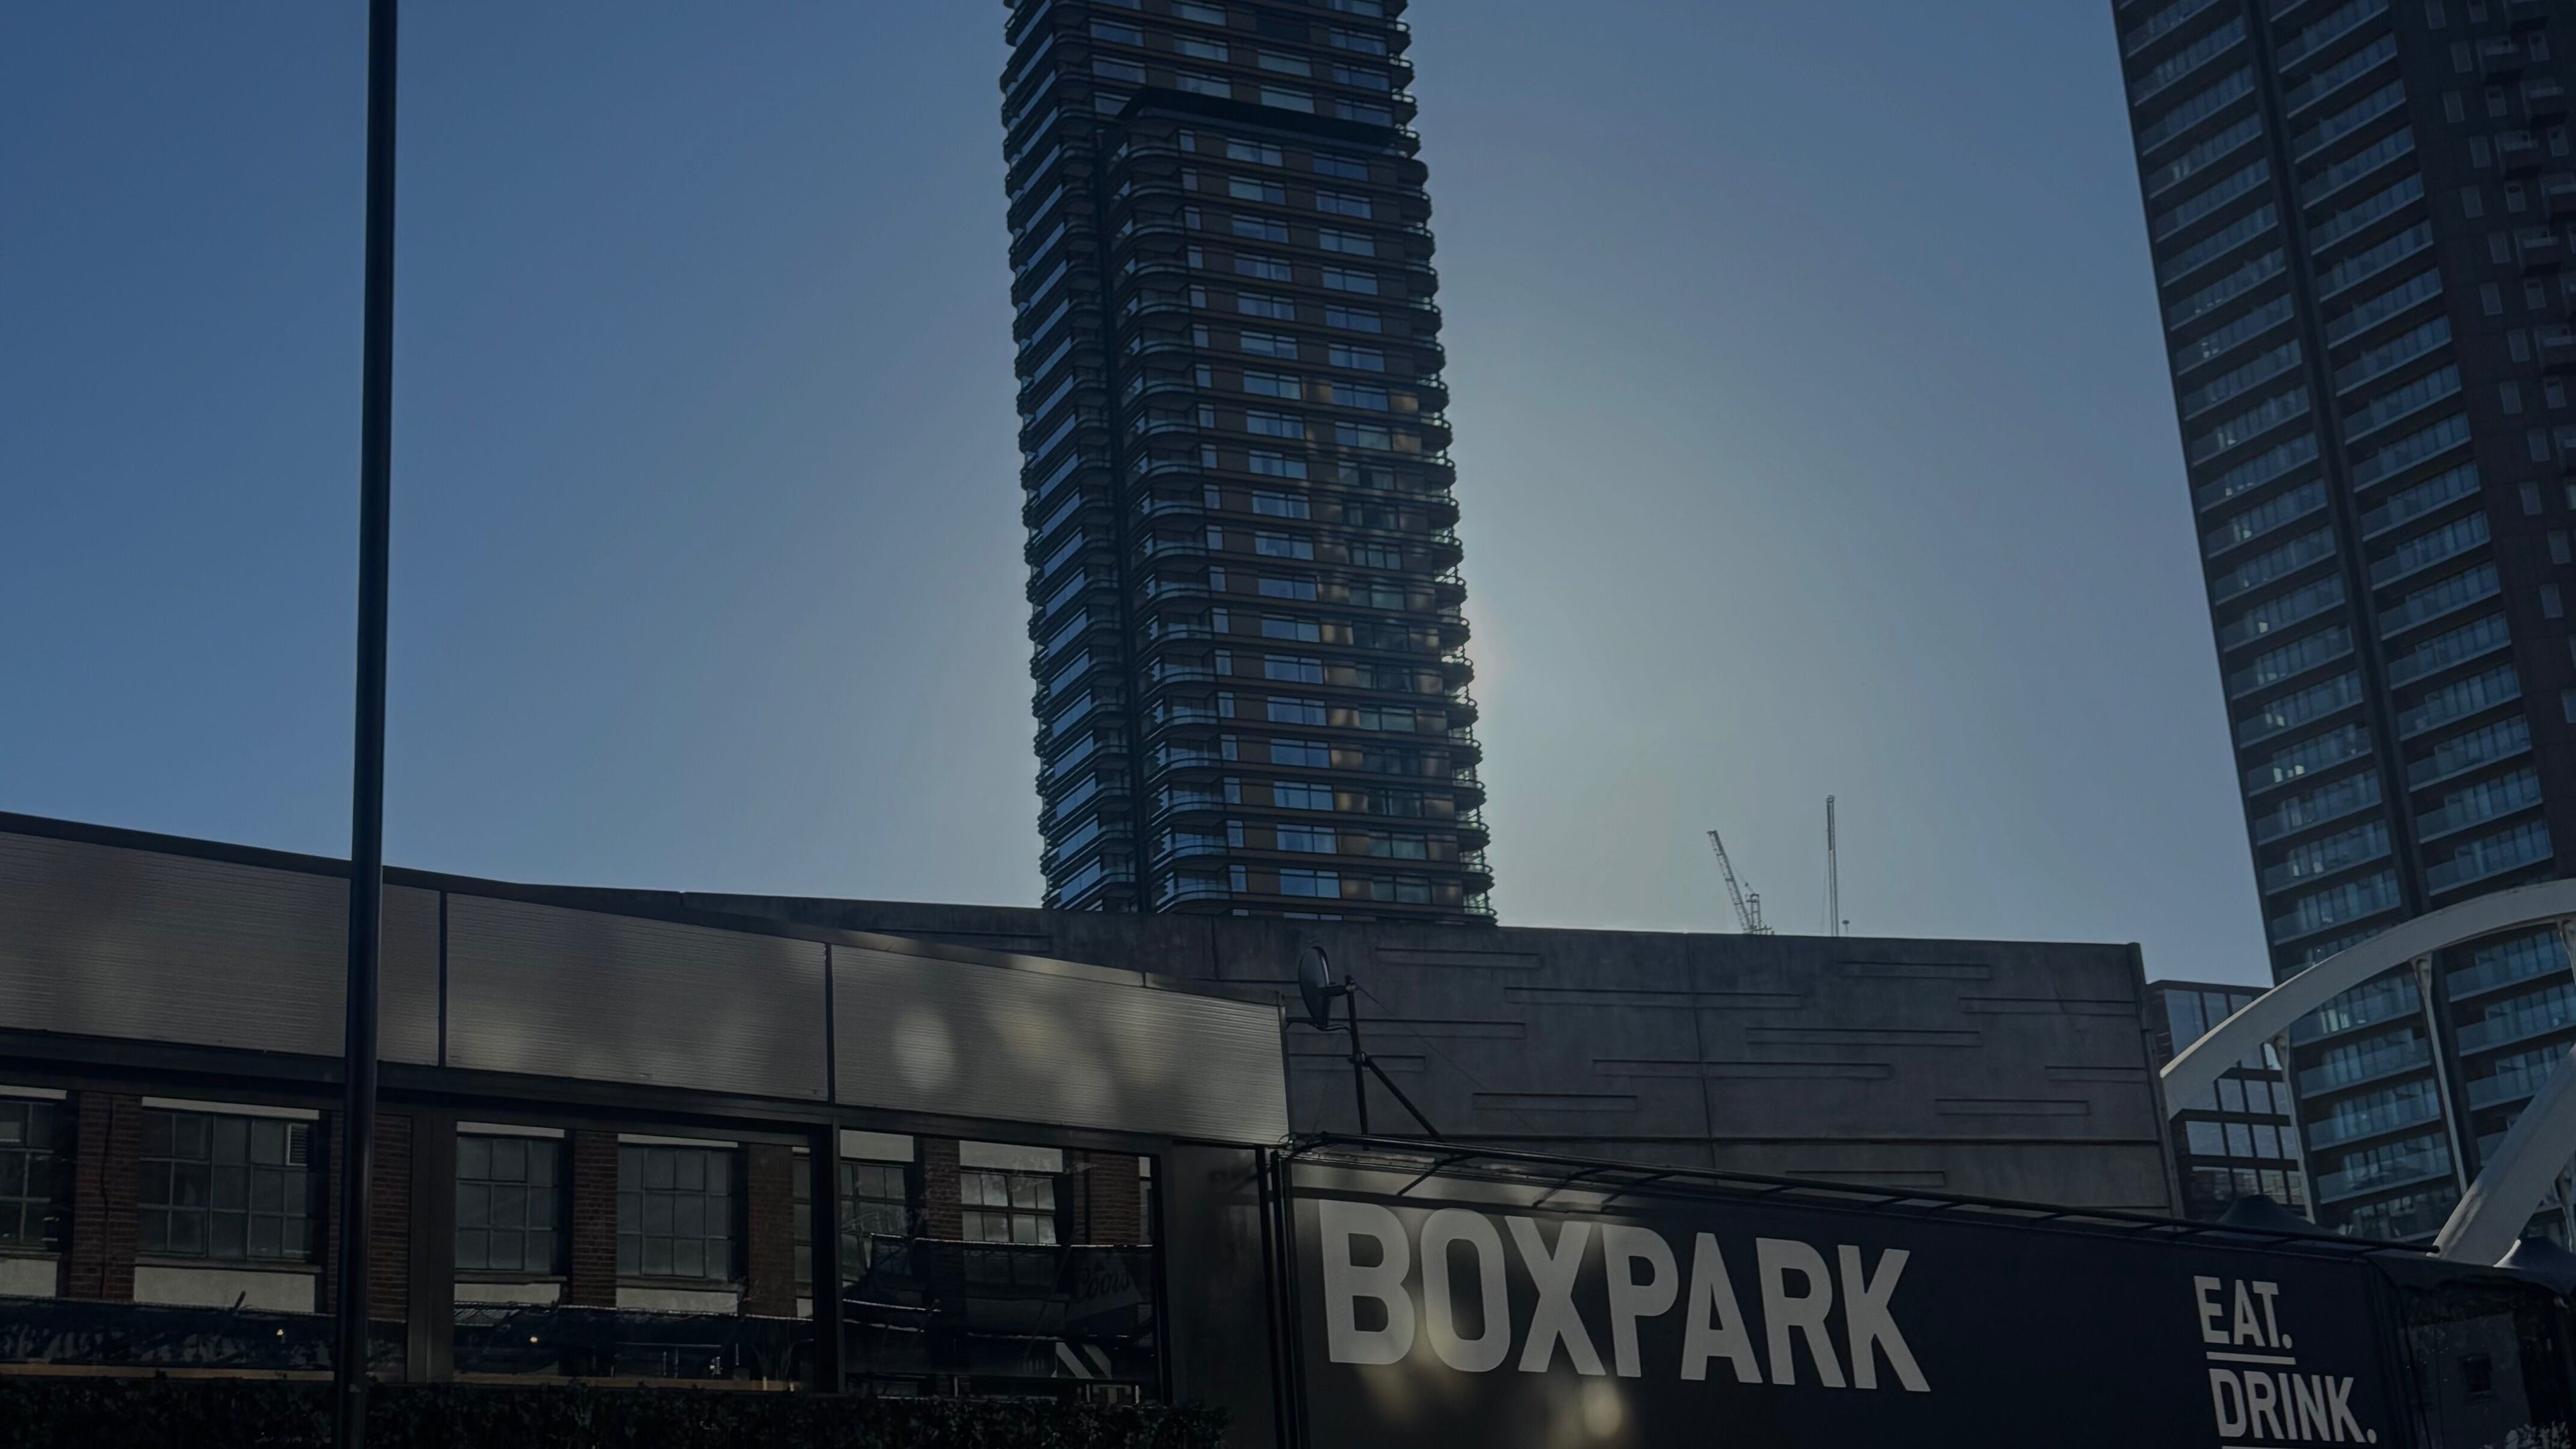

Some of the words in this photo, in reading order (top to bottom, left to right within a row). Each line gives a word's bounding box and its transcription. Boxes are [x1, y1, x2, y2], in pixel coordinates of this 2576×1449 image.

[1319, 1199, 1931, 1393] BOXPARK
[2194, 1275, 2294, 1349] EAT.
[2208, 1368, 2377, 1444] DRINK.
